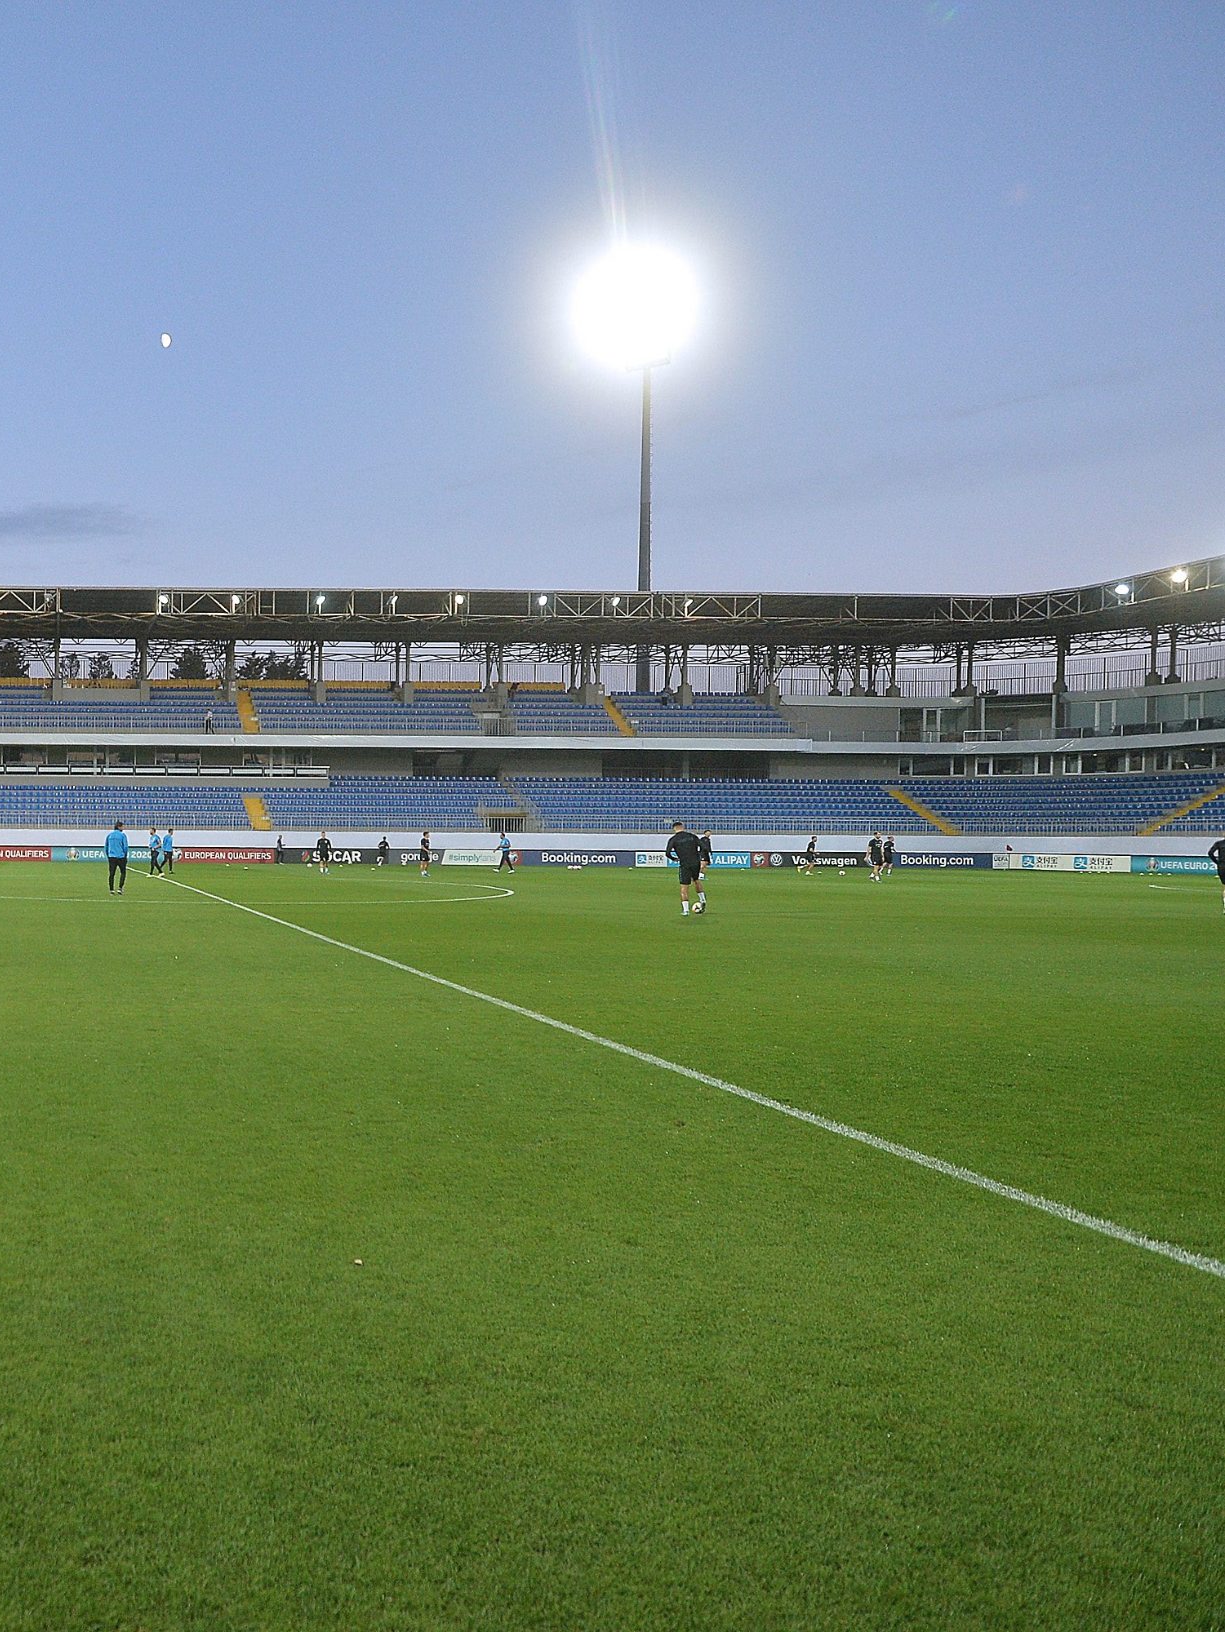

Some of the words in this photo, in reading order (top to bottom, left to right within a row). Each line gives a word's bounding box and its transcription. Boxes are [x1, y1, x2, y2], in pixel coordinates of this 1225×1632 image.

[4, 849, 49, 859] QUALIFIERS
[81, 850, 105, 859] UEFA
[184, 851, 226, 860] EUROPEAN
[226, 852, 271, 861] QUALIFIERS
[400, 852, 439, 863] gorje
[541, 852, 616, 864] Booking.com
[715, 855, 749, 865] ALIPAY
[791, 855, 858, 868] Voswagen
[900, 854, 974, 867] Booking.com
[1160, 861, 1184, 870] UEFA
[1184, 861, 1208, 870] EURO
